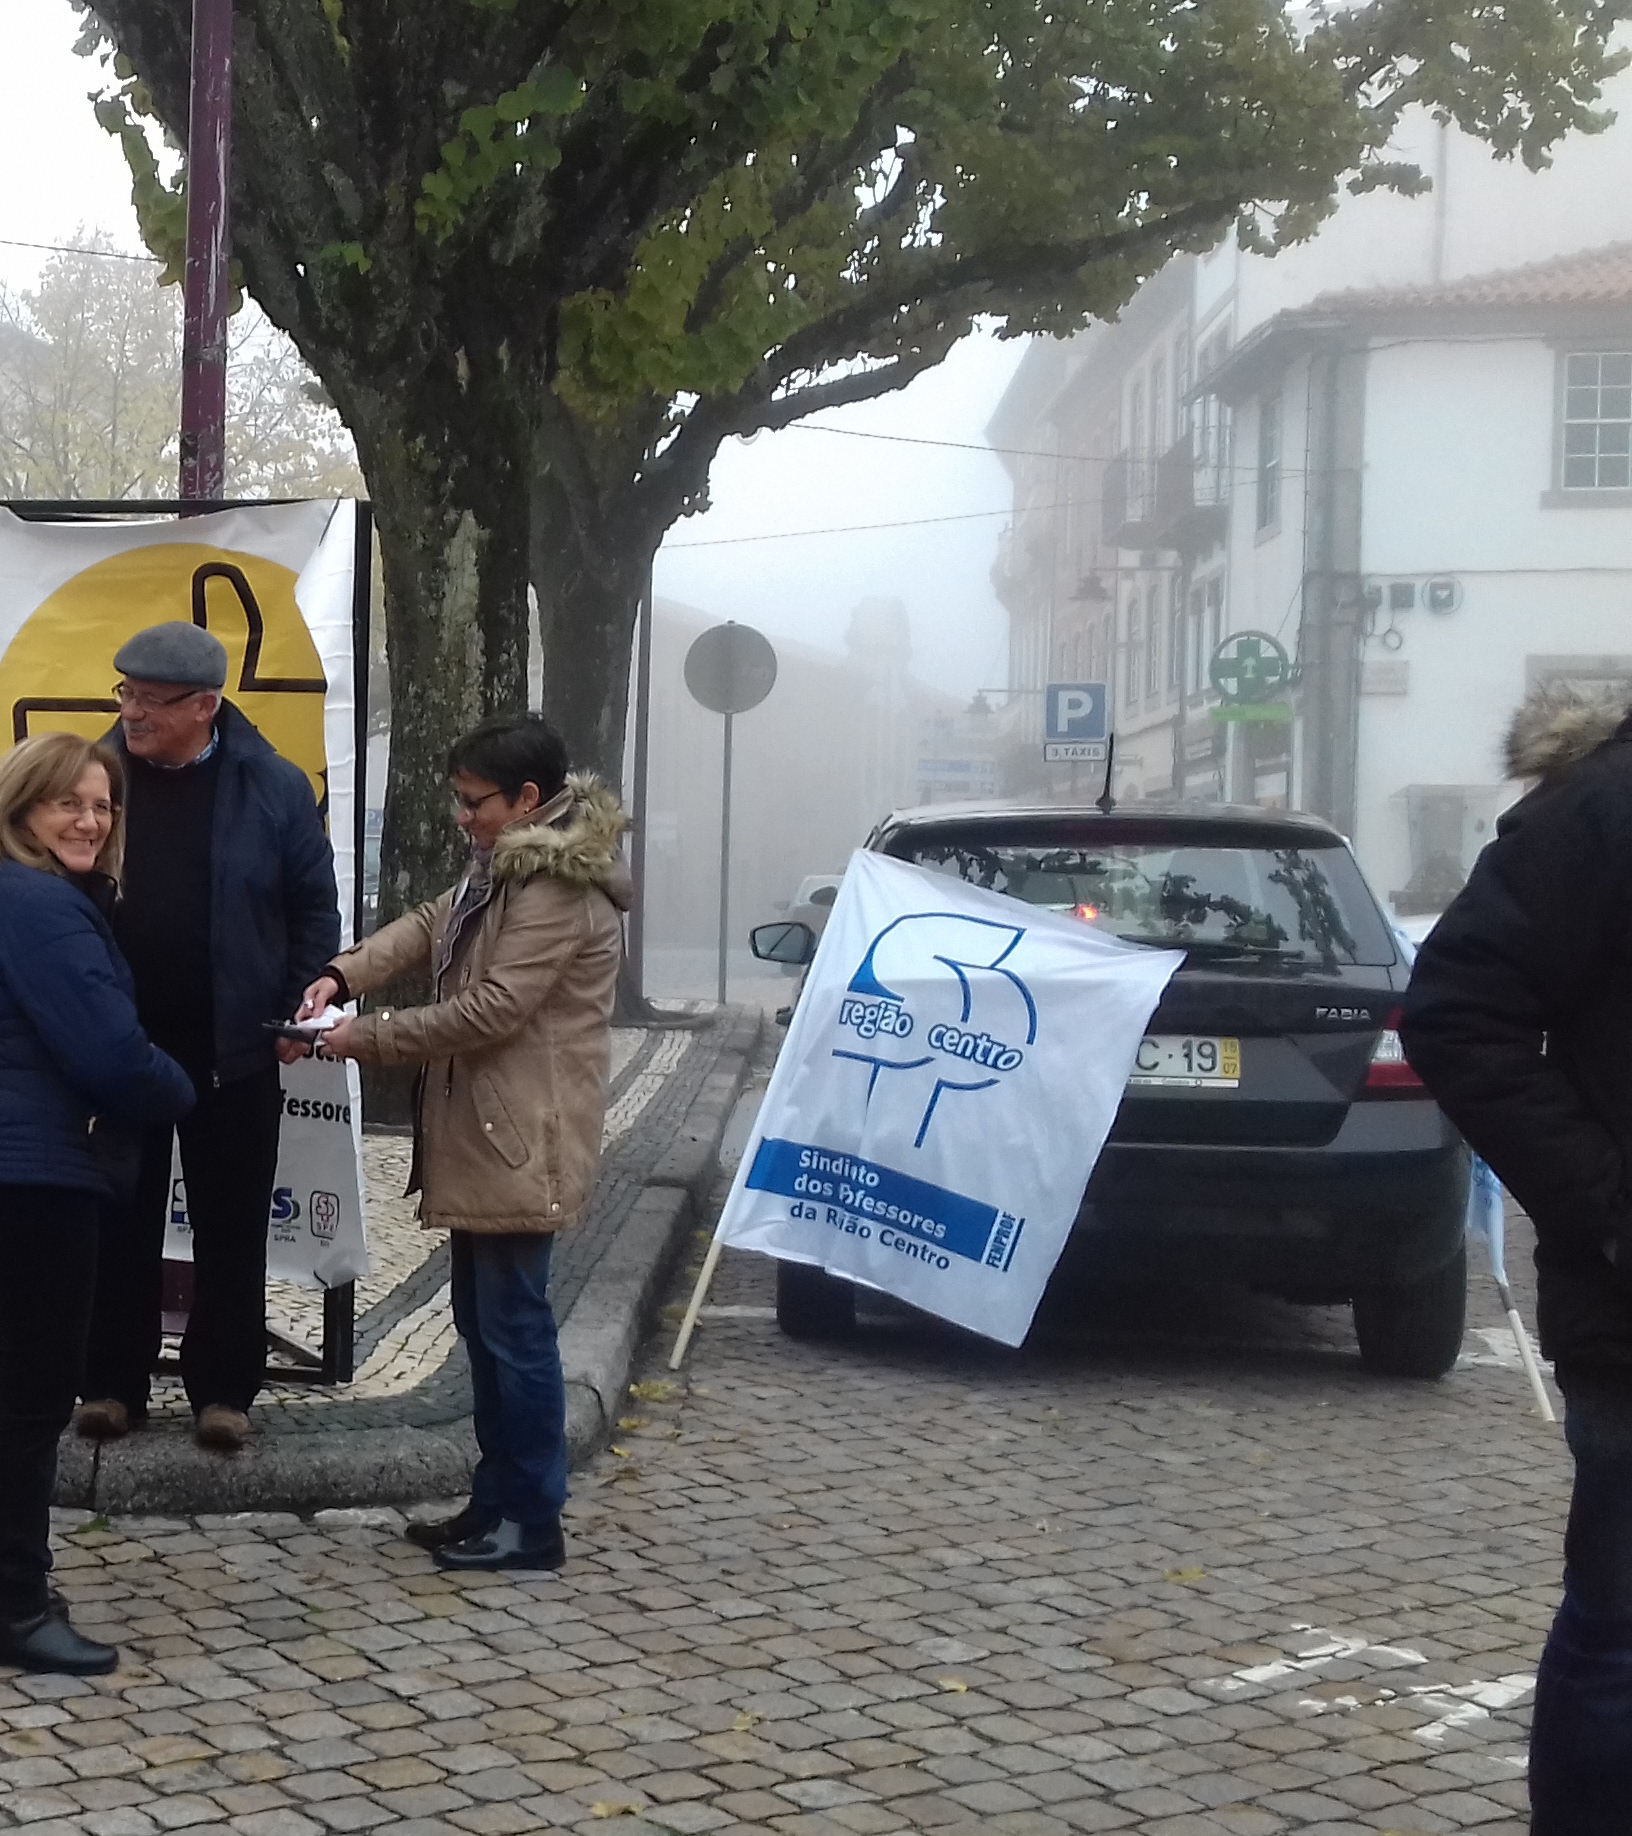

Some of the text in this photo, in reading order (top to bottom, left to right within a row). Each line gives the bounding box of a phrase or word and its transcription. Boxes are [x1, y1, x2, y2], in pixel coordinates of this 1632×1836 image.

[1057, 690, 1093, 732] P
[1064, 747, 1100, 757] TAXIS
[1315, 1007, 1372, 1020] FABIA
[839, 997, 1023, 1072] região centro
[280, 1089, 351, 1125] fessore
[794, 1172, 834, 1196] dos
[790, 1201, 818, 1221] da
[879, 1228, 950, 1270] Centro
